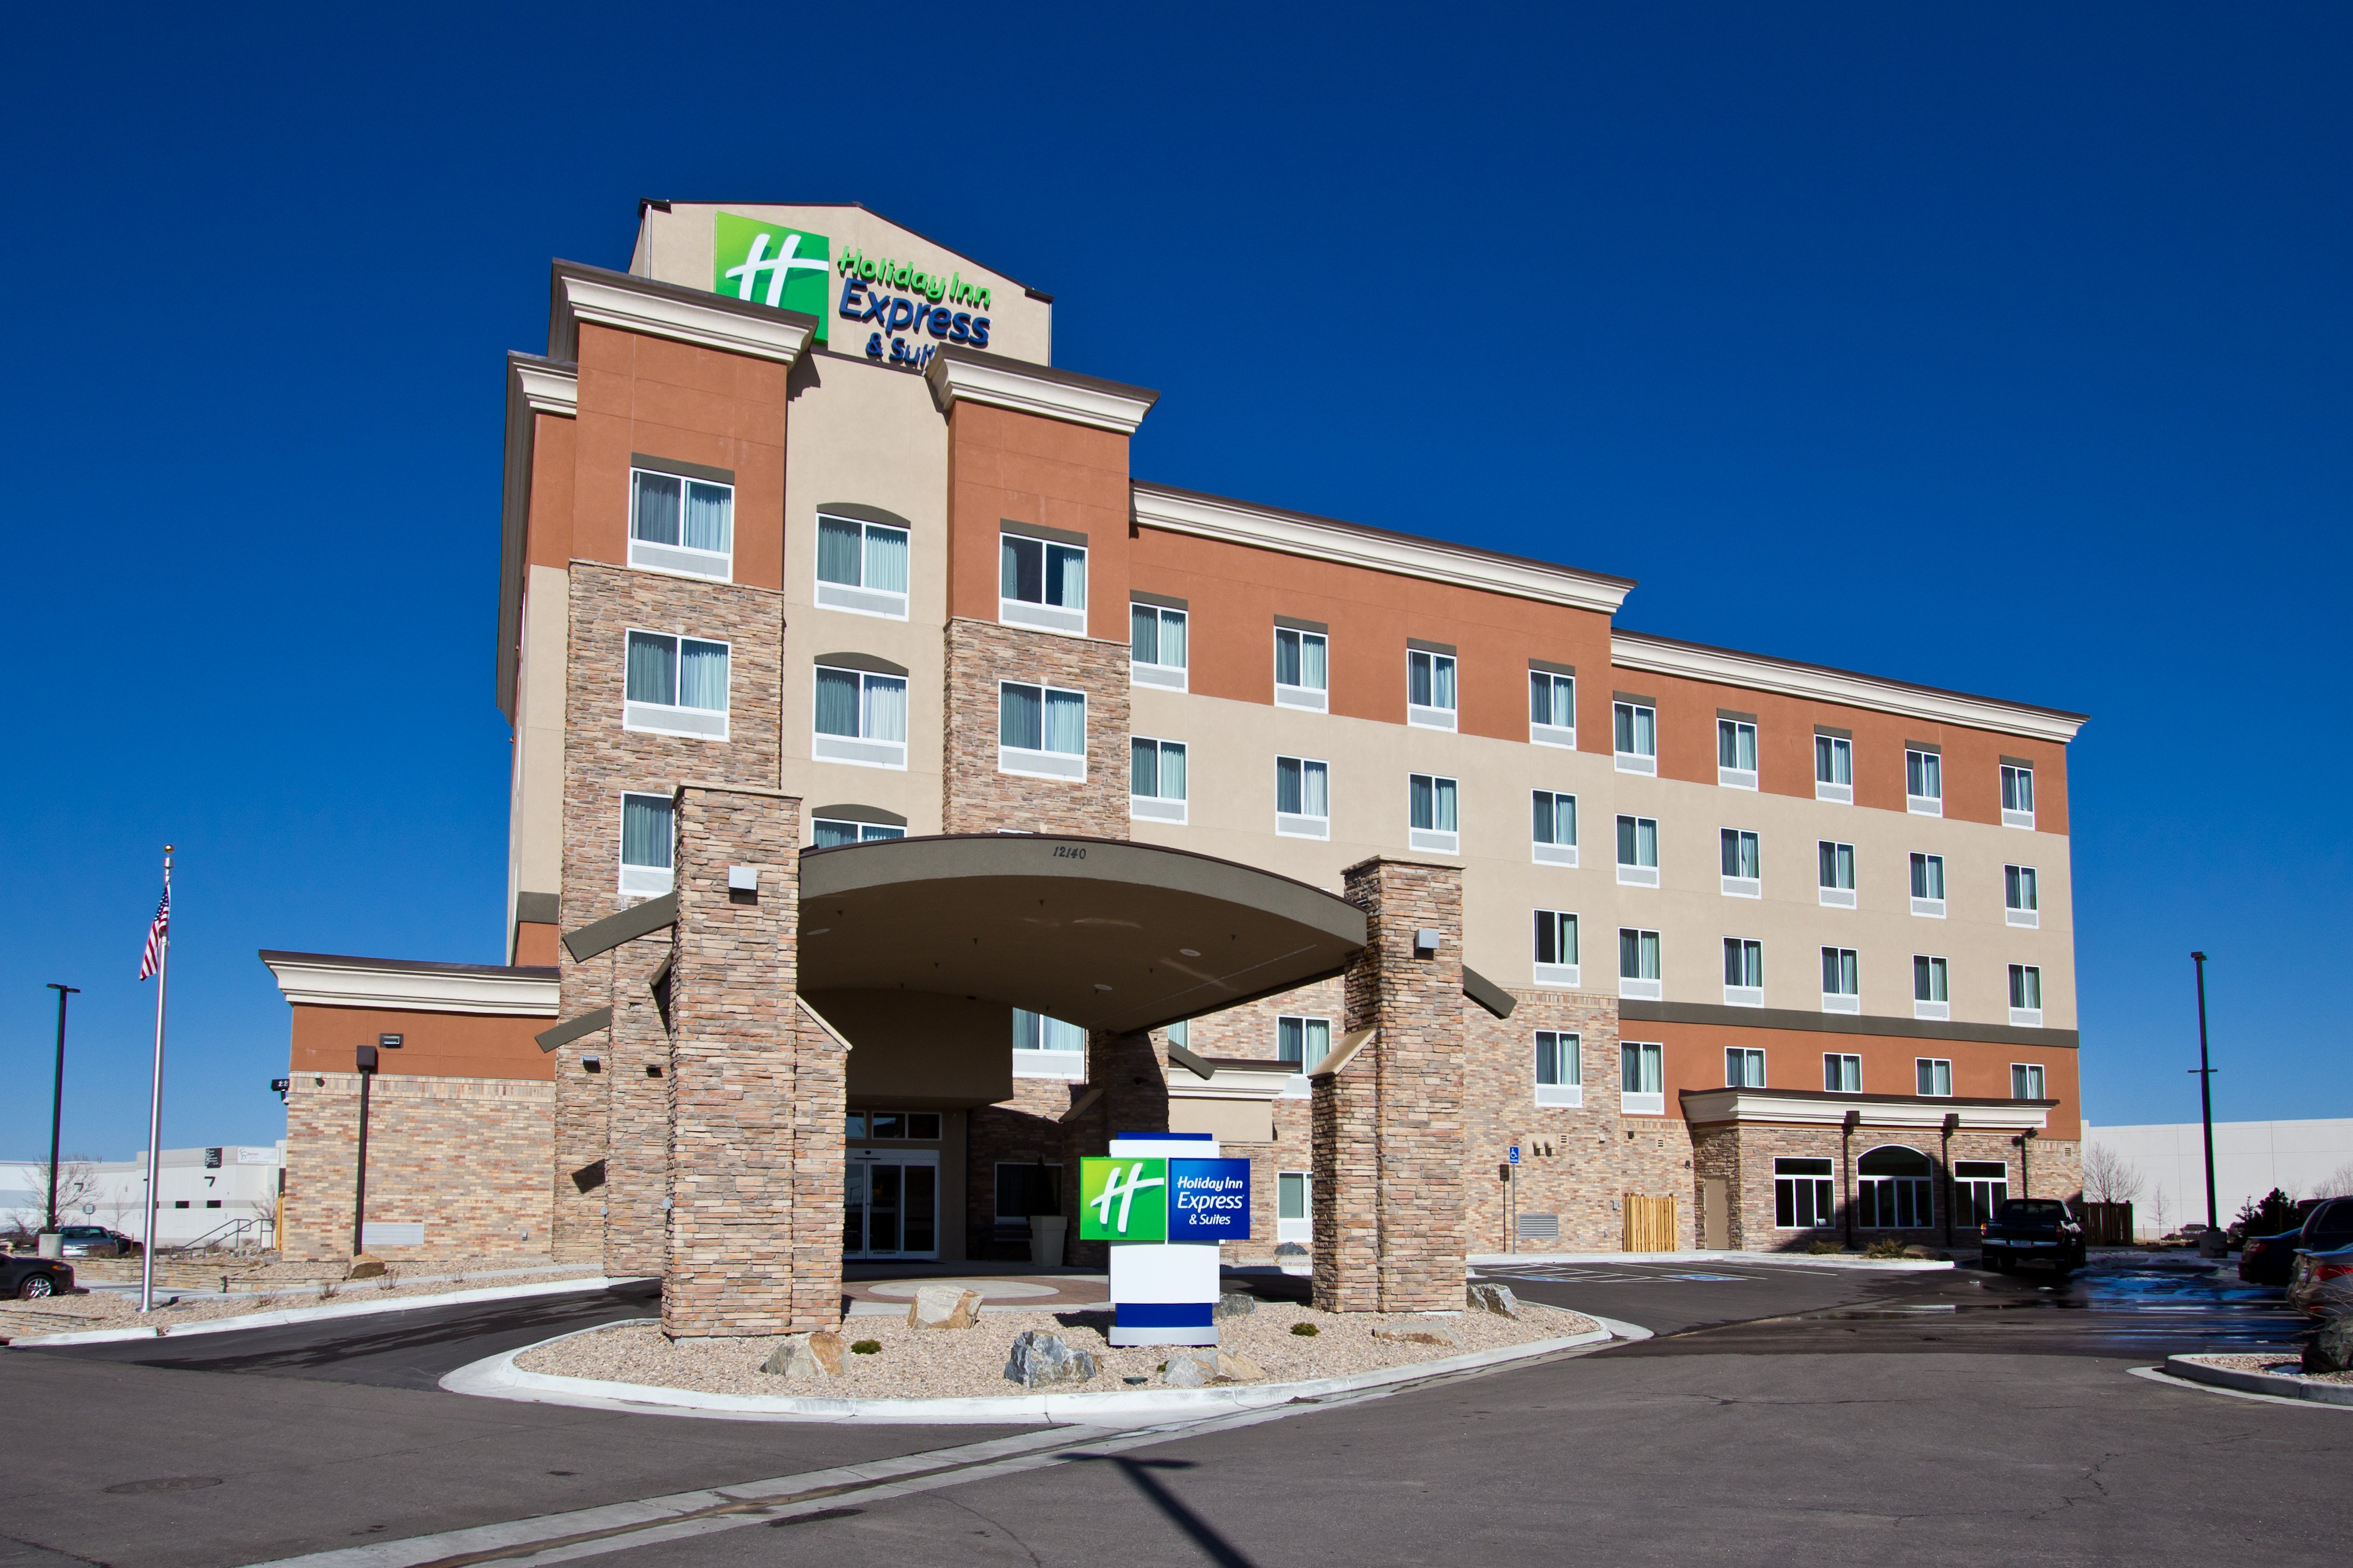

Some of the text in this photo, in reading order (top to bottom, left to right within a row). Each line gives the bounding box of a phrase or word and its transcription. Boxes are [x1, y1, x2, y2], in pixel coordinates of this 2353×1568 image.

[837, 246, 991, 306] Holiday Inn
[839, 277, 991, 344] Express
[865, 332, 936, 366] & Suit
[1052, 846, 1086, 859] 12140
[1177, 1176, 1243, 1192] Holiday Inn
[1177, 1191, 1243, 1213] Express
[1189, 1214, 1231, 1225] & Suites
